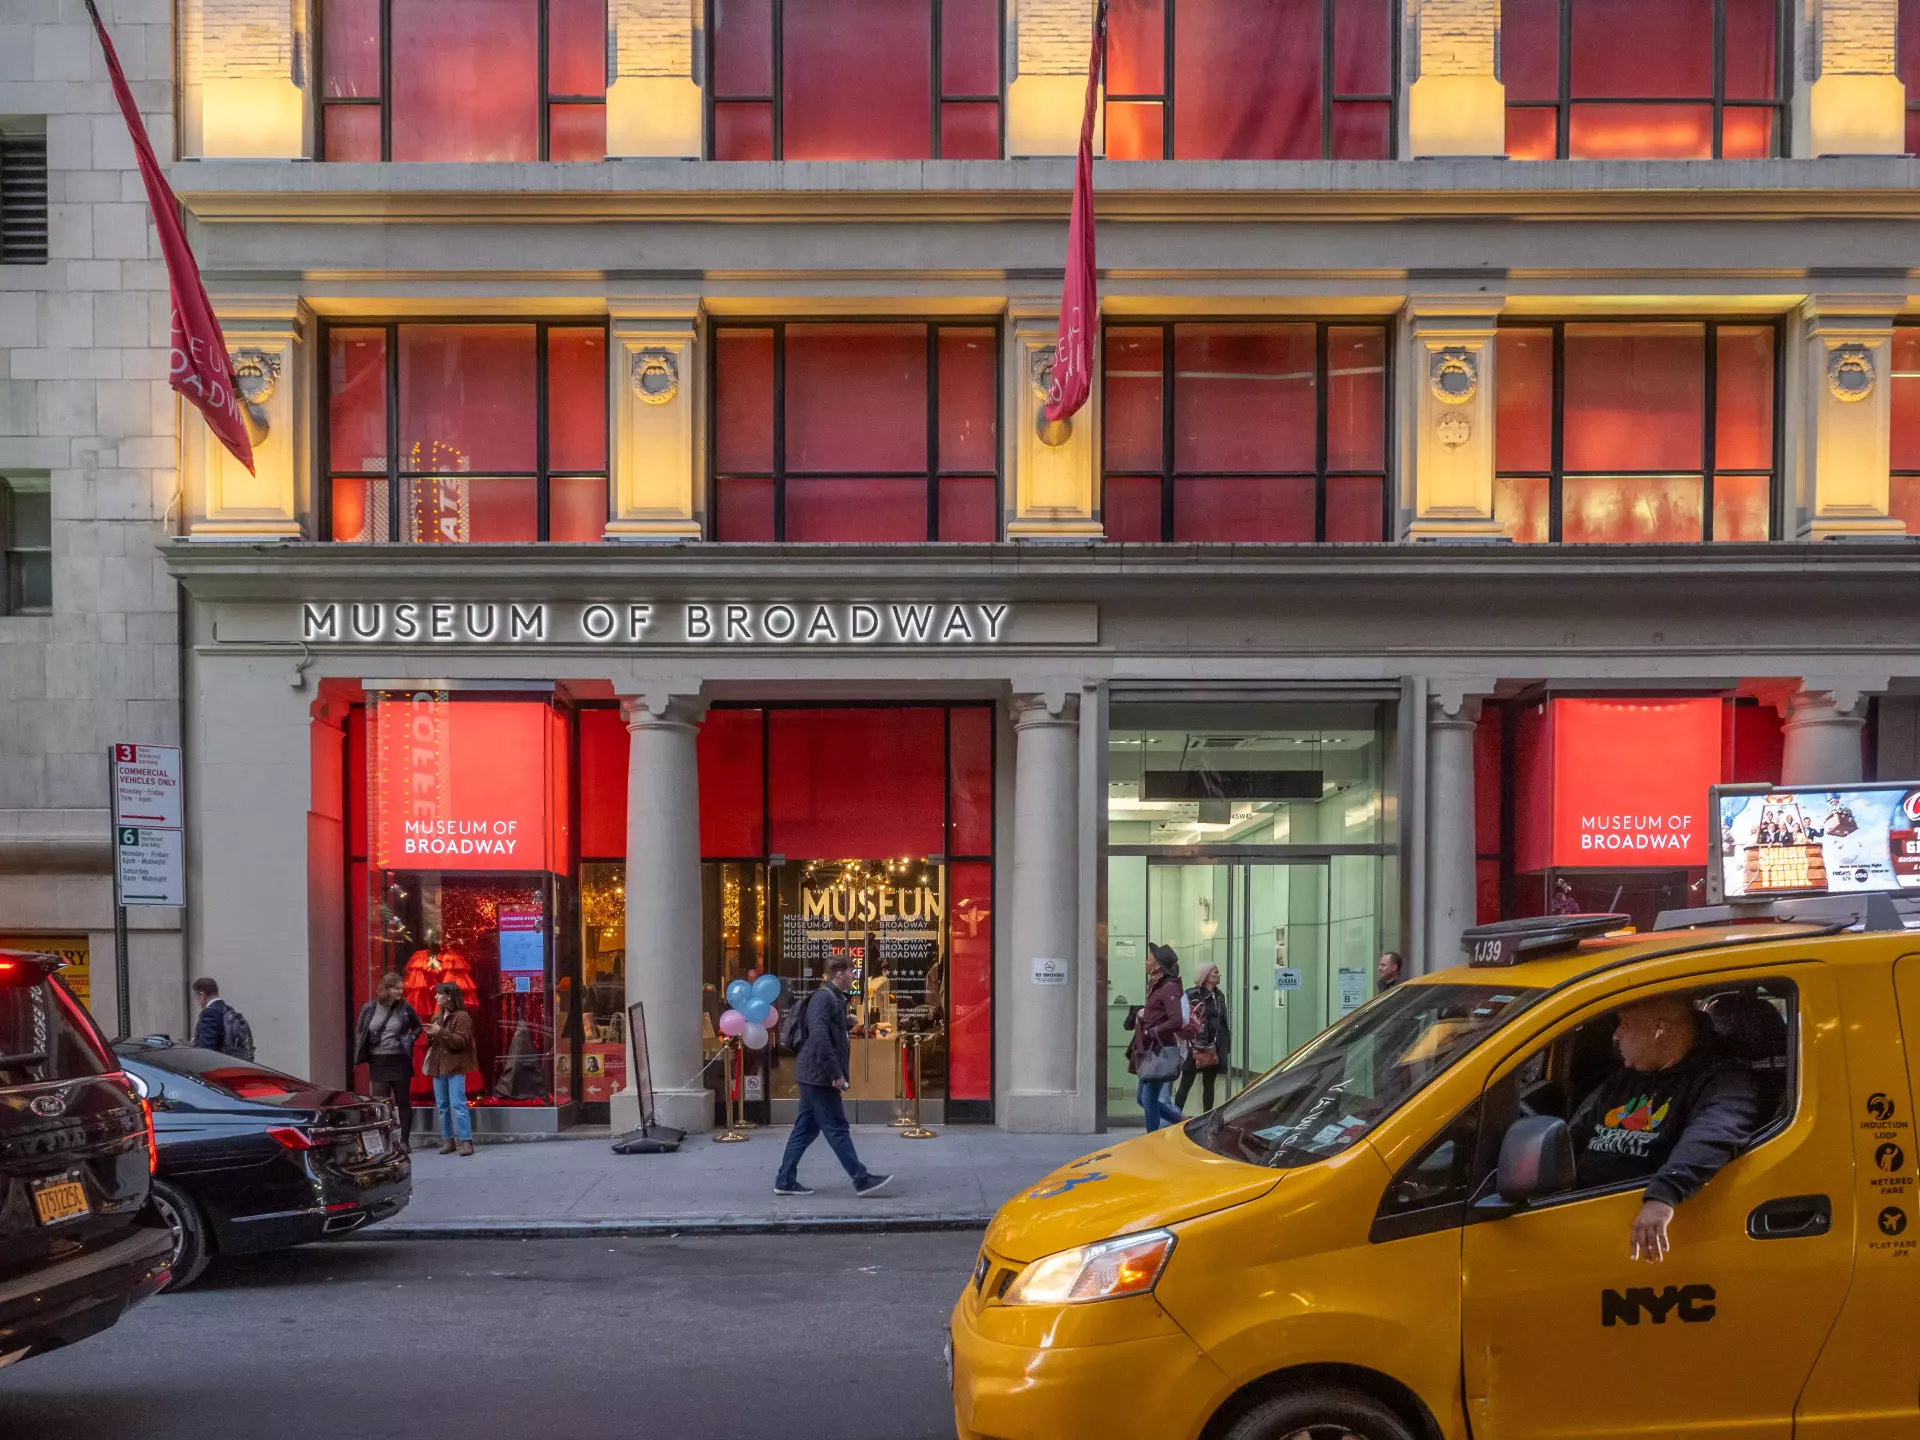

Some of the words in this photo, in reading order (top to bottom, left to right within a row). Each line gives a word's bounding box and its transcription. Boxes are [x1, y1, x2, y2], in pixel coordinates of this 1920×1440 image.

[304, 604, 544, 638] MUSEUM
[582, 604, 650, 639] OF
[687, 604, 1007, 638] BROADWAY
[120, 745, 132, 761] 3
[120, 766, 168, 778] COMMERCIAL
[120, 776, 156, 785] VEHICLES
[158, 778, 176, 787] ONLY
[404, 820, 487, 835] MUSEUM
[493, 820, 518, 835] OF
[1581, 815, 1662, 830] MUSEUM
[1668, 815, 1692, 830] OF
[123, 829, 135, 845] 6
[1581, 834, 1692, 849] BROADWAY
[405, 838, 518, 854] BROADWAY
[122, 868, 149, 876] Saturday
[142, 875, 168, 883] Midnight
[1474, 940, 1502, 962] 1J39
[1875, 1132, 1898, 1140] LOOP
[1870, 1177, 1913, 1186] METERED
[1870, 1242, 1892, 1250] FLAT
[1894, 1240, 1917, 1249] FARE
[1602, 1284, 1716, 1327] NYC
